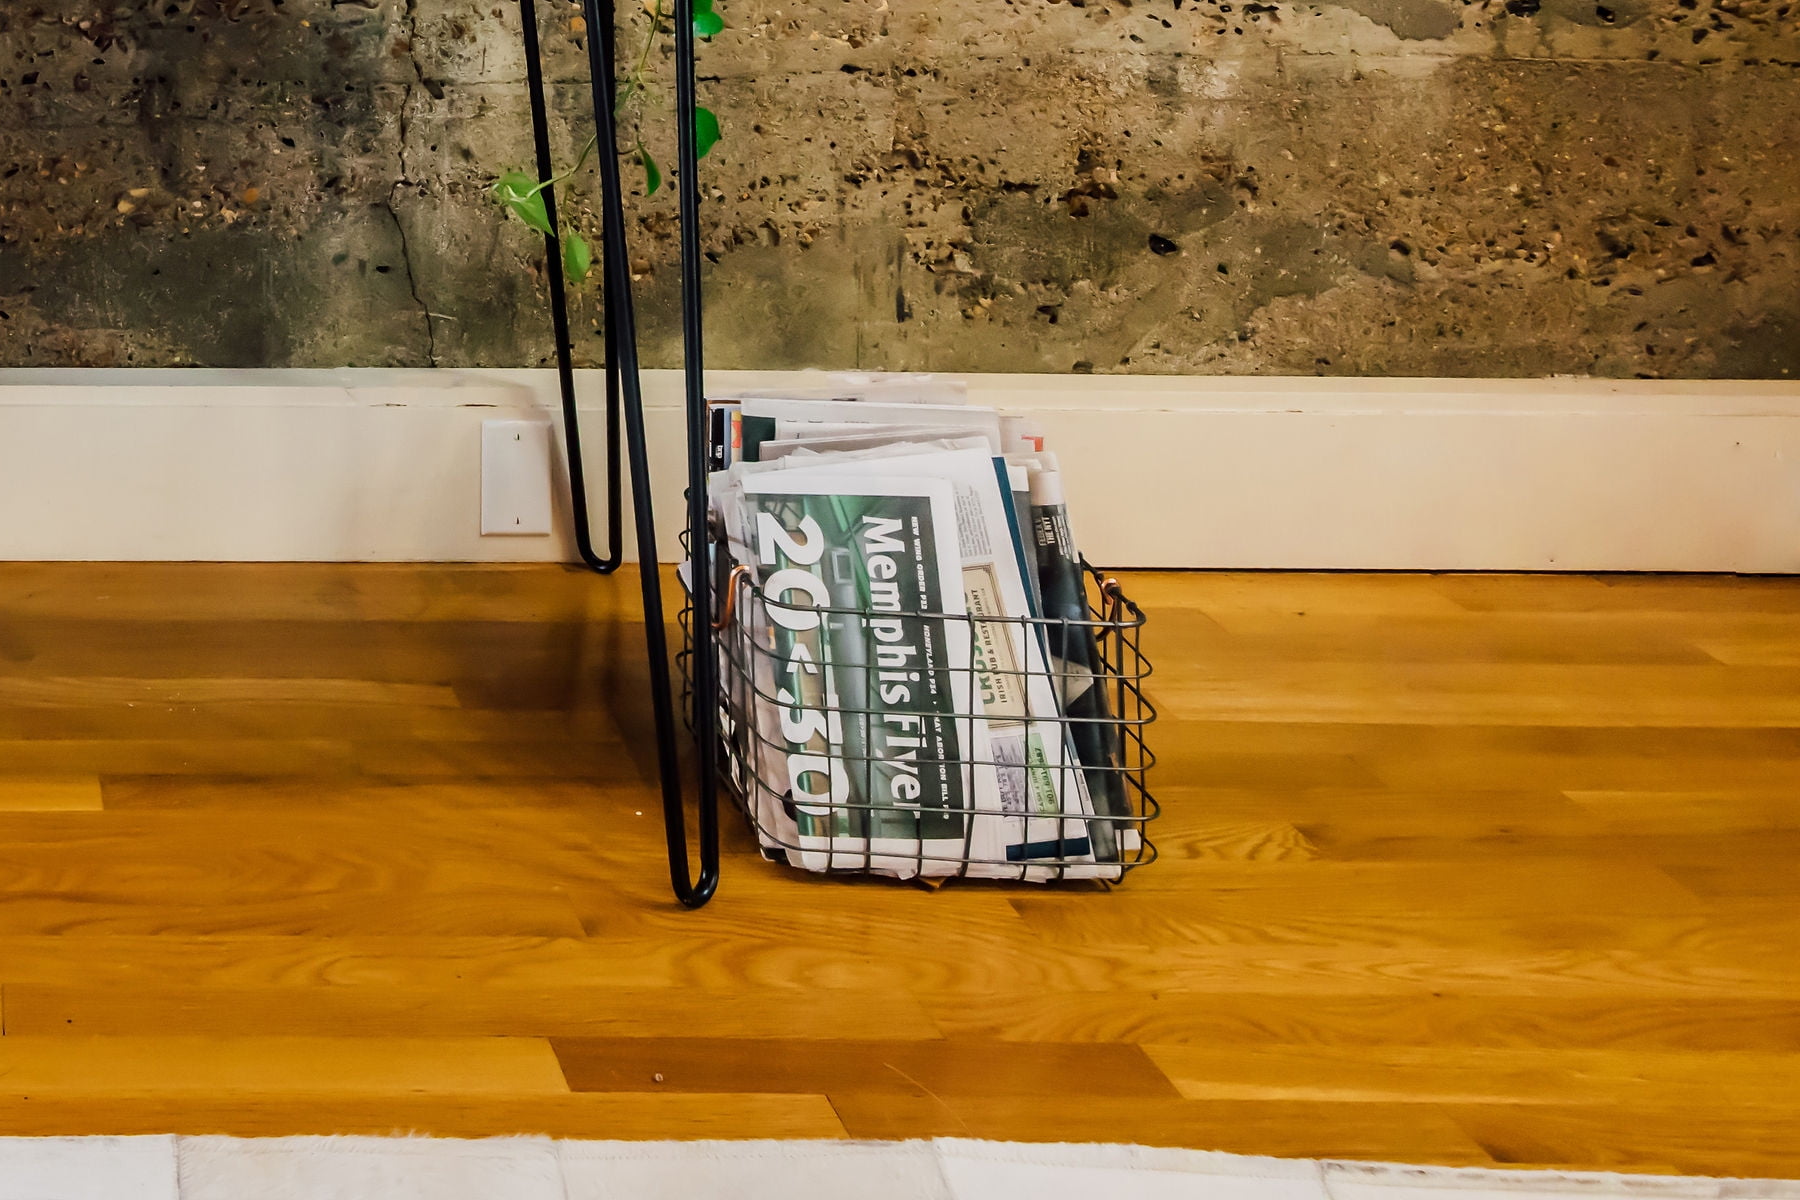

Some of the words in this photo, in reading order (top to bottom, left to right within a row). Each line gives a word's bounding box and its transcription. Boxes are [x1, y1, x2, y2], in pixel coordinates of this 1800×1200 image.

[911, 516, 920, 536] NEW
[913, 538, 923, 562] WING
[916, 563, 926, 592] ORDER
[861, 515, 920, 704] Memphis
[995, 678, 1007, 703] IRISH
[875, 713, 927, 819] Flyer
[935, 735, 947, 781] ABORION
